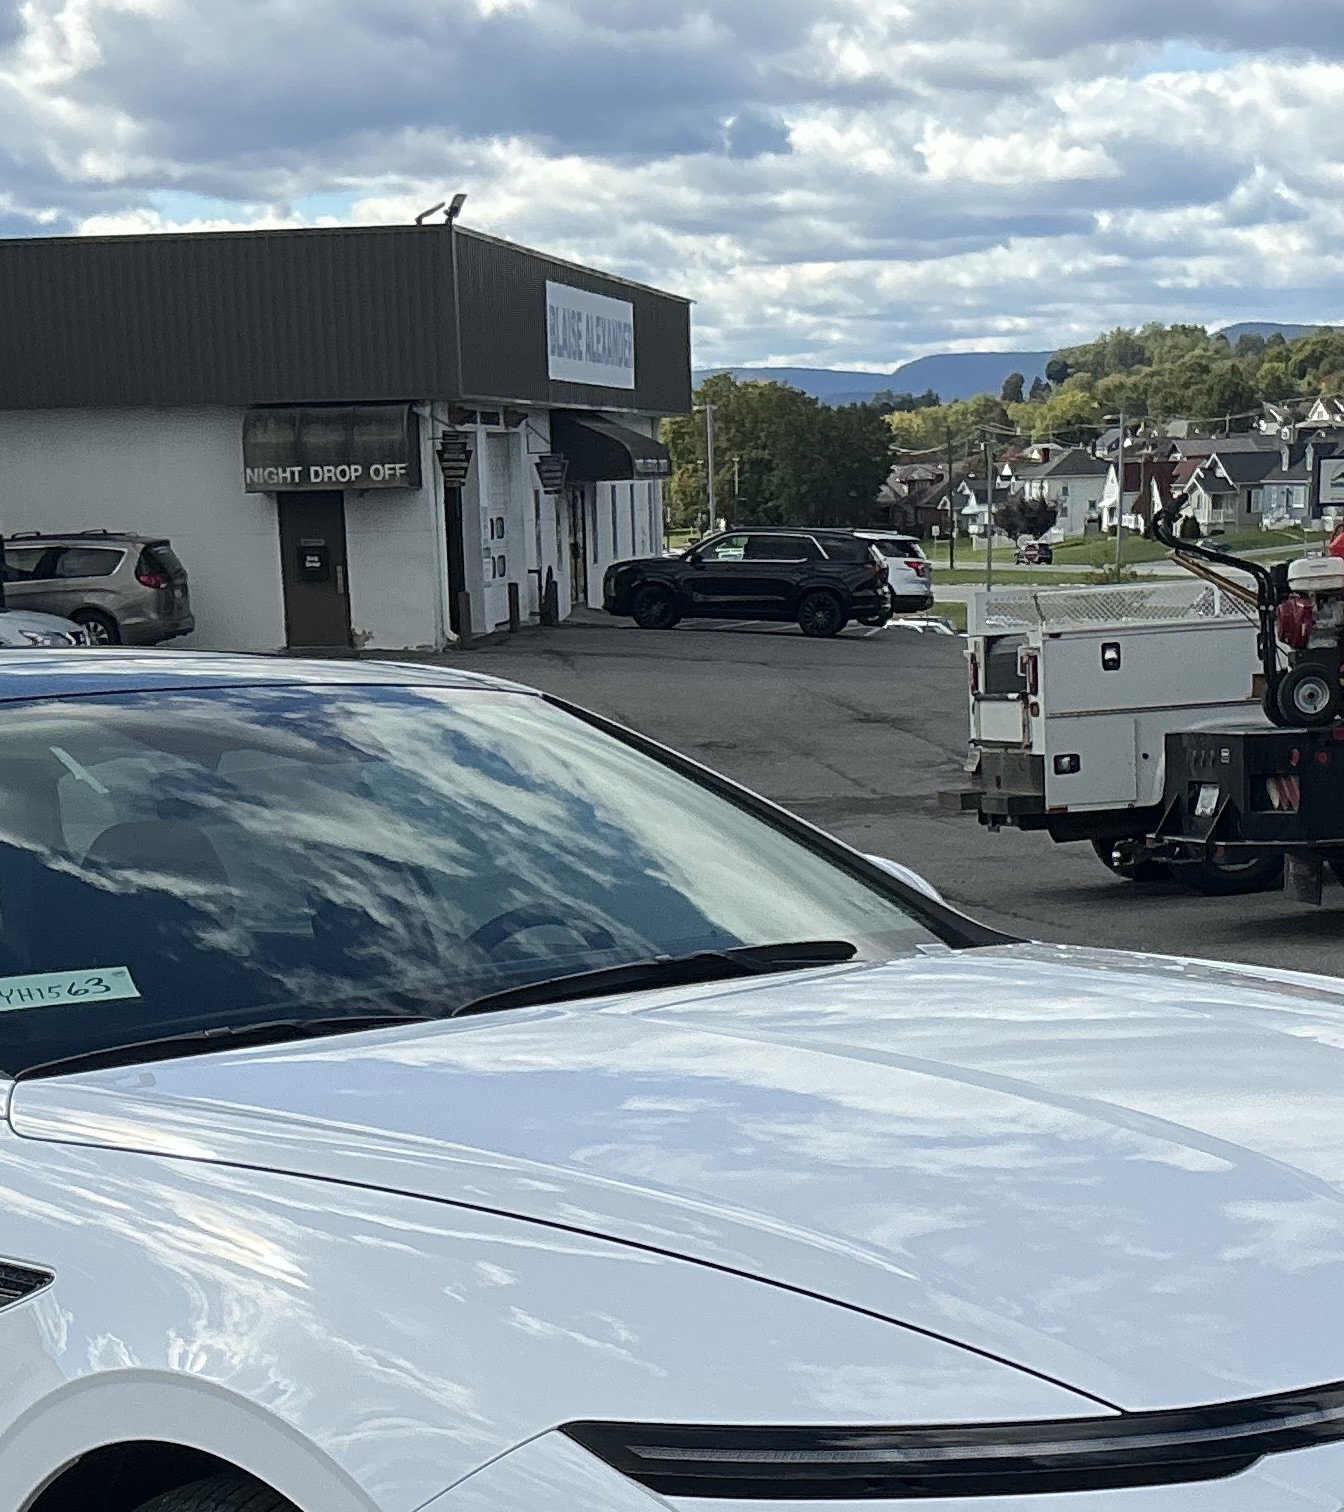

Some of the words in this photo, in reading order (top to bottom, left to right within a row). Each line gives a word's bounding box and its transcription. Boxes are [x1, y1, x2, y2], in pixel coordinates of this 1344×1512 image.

[245, 466, 302, 484] NIGHT
[309, 465, 362, 483] DROP
[369, 463, 408, 481] OFF
